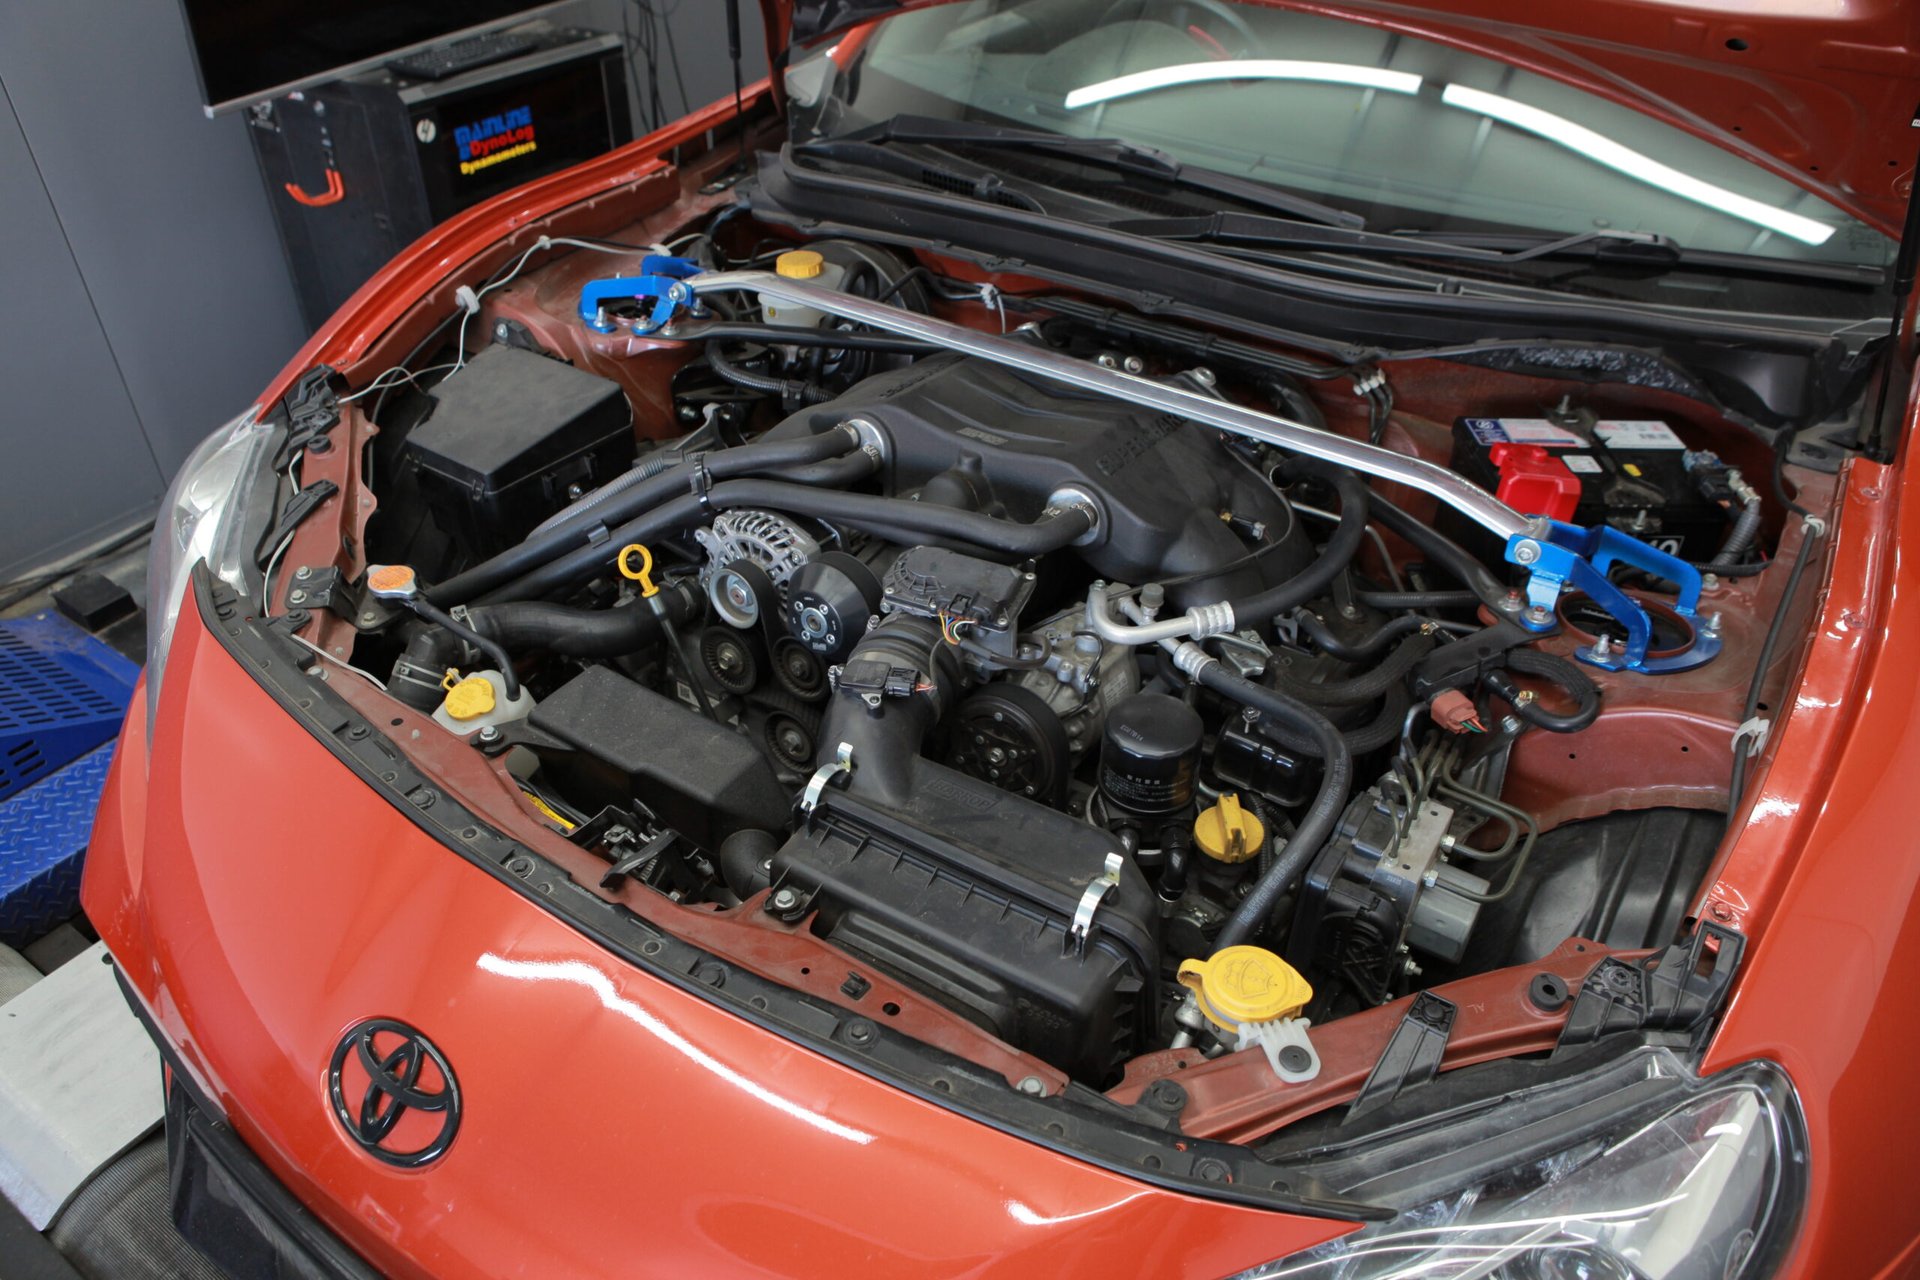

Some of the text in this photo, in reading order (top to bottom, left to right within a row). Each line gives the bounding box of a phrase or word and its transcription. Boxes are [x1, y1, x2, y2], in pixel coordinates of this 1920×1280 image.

[454, 106, 532, 150] MAINLINE
[469, 126, 534, 156] DynoLog
[460, 142, 537, 175] Dynamometers
